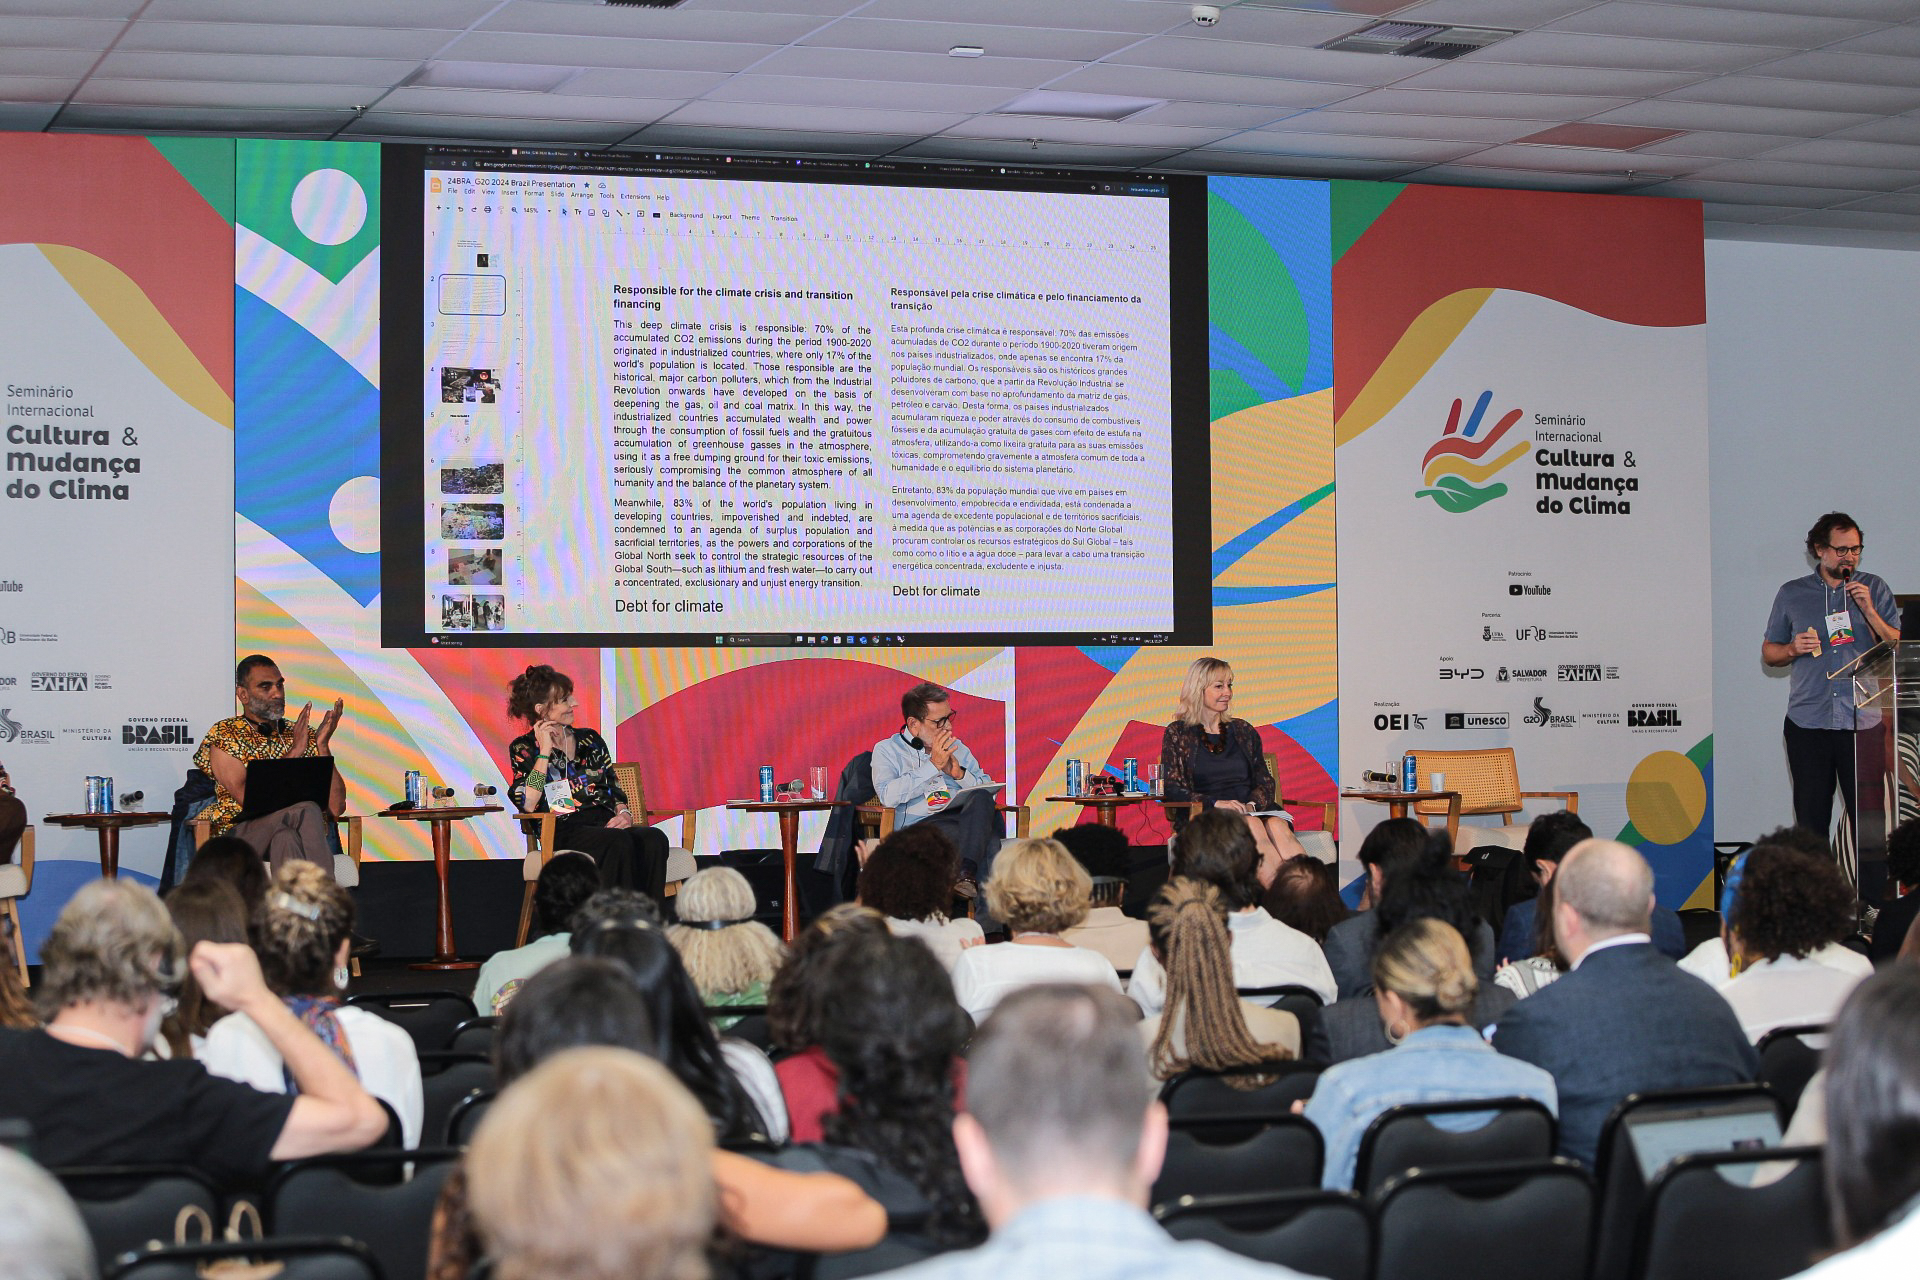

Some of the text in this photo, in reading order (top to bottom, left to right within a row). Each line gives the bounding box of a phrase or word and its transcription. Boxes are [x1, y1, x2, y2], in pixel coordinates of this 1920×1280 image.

[614, 285, 852, 300] Responsible for the climate crisis and transition
[891, 288, 948, 299] Responsável
[951, 290, 969, 299] pela
[996, 291, 1035, 300] climática
[1046, 293, 1064, 302] pelo
[1067, 294, 1128, 303] financiamento
[614, 299, 660, 311] financing
[891, 302, 932, 311] transição
[614, 320, 871, 334] This deep climate crisis is responsible: 70% of the
[614, 334, 669, 342] accumulated
[674, 334, 694, 342] CO2
[746, 336, 772, 346] during
[796, 338, 822, 347] period
[827, 338, 871, 347] 1900-2020
[614, 347, 656, 357] originated
[672, 348, 728, 357] industrialized
[776, 350, 802, 358] where
[806, 351, 823, 361] only
[827, 351, 845, 359] 17%
[858, 352, 871, 360] the
[7, 385, 73, 398] Seminário
[7, 404, 94, 417] Internacional
[1534, 414, 1586, 426] Seminário
[7, 425, 138, 446] Cultura &
[1535, 431, 1602, 443] Internacional
[1535, 449, 1636, 468] Cultura &
[6, 477, 129, 500] do Clima
[674, 499, 692, 507] 83%
[782, 501, 826, 510] population
[835, 501, 856, 510] living
[1536, 495, 1630, 514] do Clima
[686, 579, 739, 588] exclusionary
[761, 579, 786, 588] unjust
[789, 580, 818, 589] energy
[1524, 585, 1551, 595] YouTube
[893, 586, 980, 596] Debt for climate
[616, 599, 723, 612] Debt for climate
[1440, 669, 1484, 679] BYD
[1558, 669, 1601, 681] BAHIA
[32, 677, 87, 691] BAHIA
[1374, 714, 1408, 730] OEI
[1468, 717, 1506, 725] unesco
[1628, 710, 1682, 727] BRASIL
[122, 725, 194, 744] BRASIL
